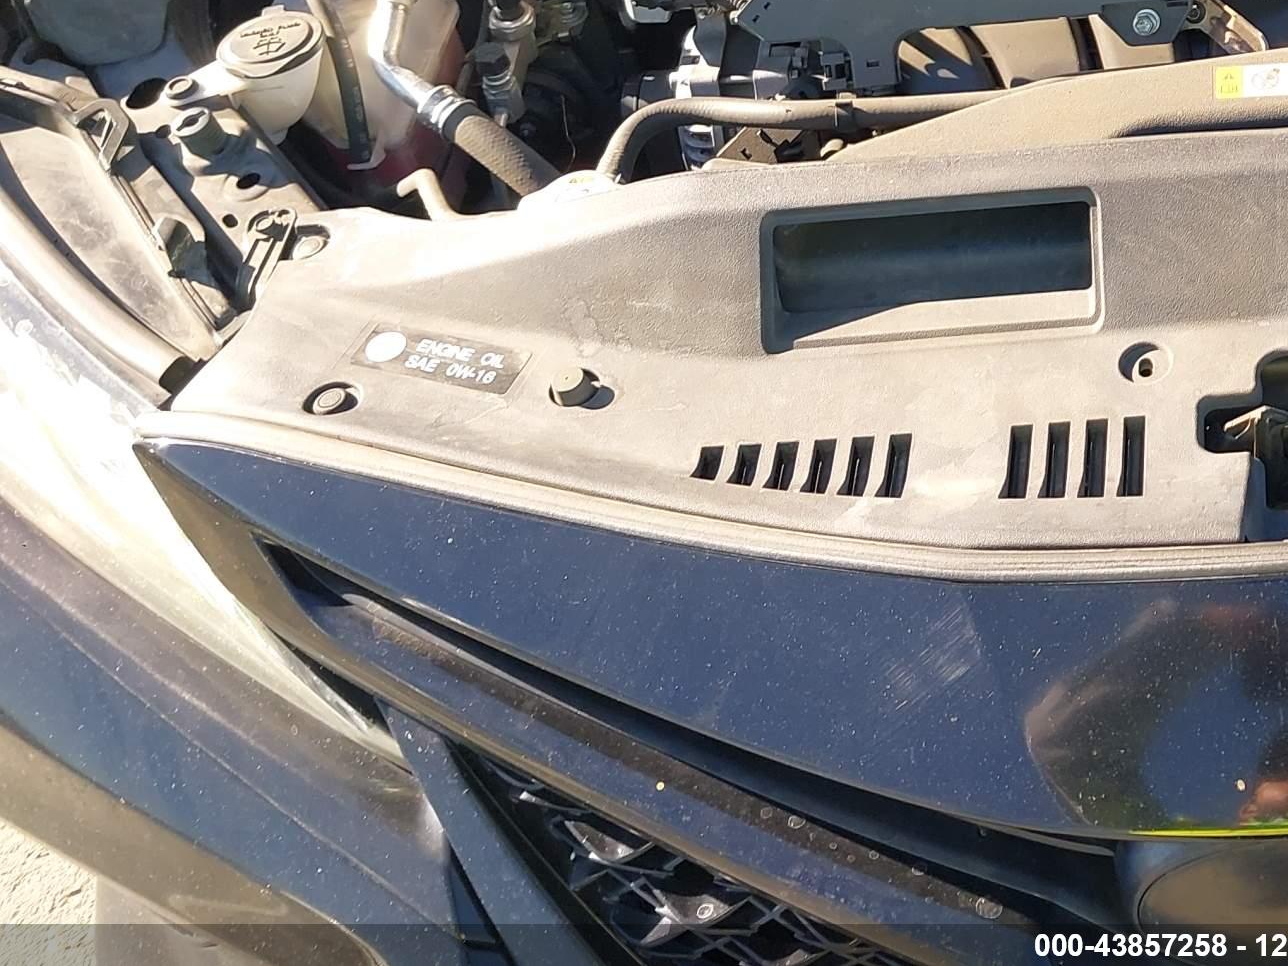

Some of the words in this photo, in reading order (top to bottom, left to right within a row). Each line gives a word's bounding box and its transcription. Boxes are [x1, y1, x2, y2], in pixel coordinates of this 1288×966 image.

[416, 338, 475, 362] ENGINE
[480, 352, 504, 369] OIL
[405, 354, 440, 373] SAE
[446, 362, 497, 384] 0W-16
